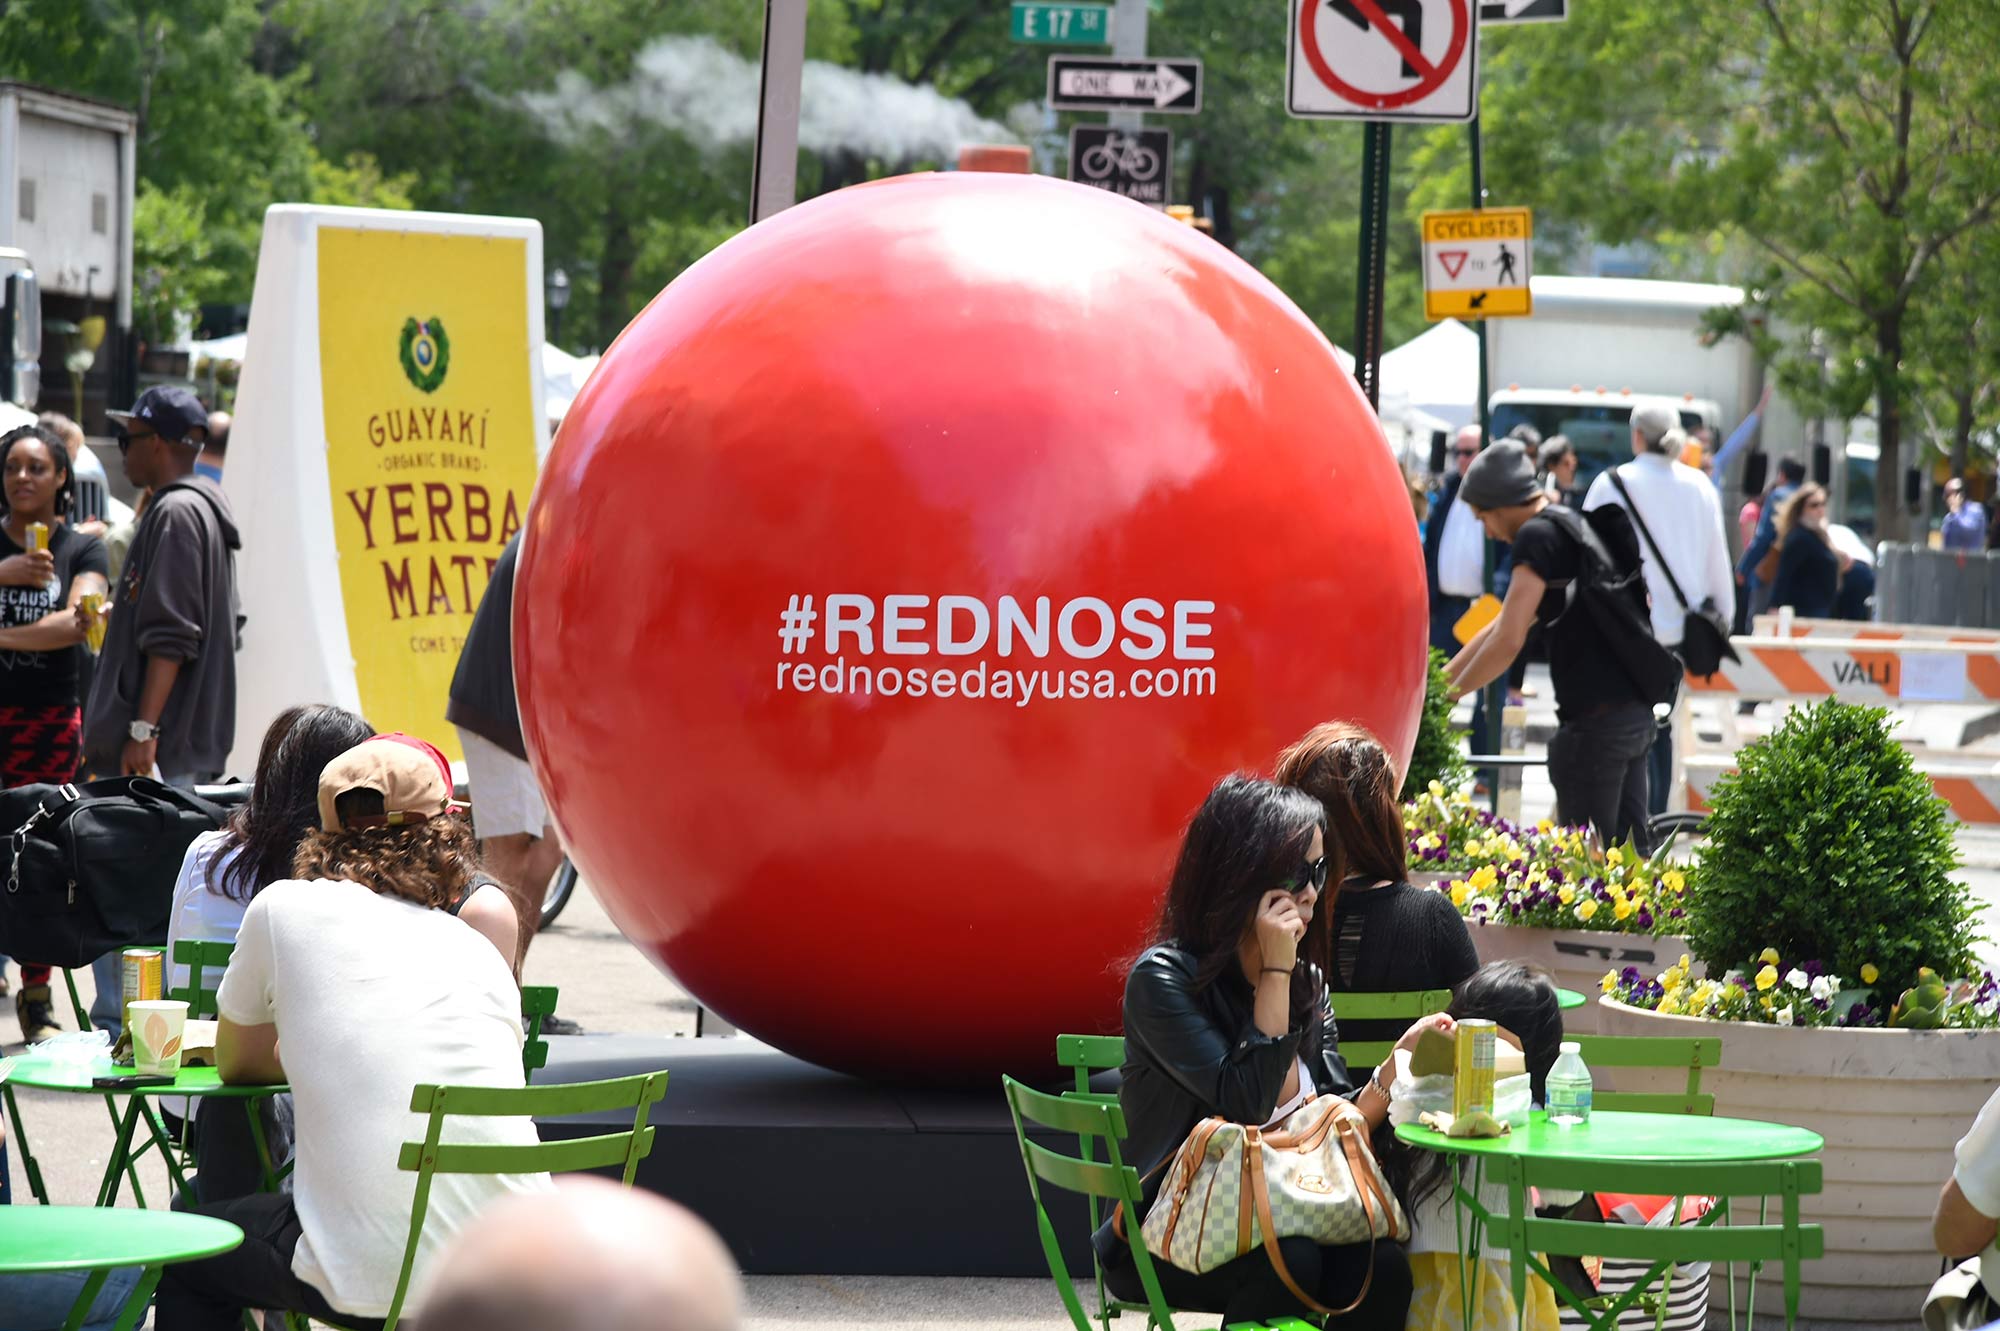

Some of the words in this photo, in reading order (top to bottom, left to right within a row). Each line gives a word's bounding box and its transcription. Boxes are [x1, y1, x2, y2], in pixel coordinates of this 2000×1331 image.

[1023, 9, 1038, 38] E
[1046, 10, 1073, 39] 17
[1071, 73, 1112, 95] ONE
[1133, 76, 1174, 95] WAY
[1116, 182, 1161, 200] LANE
[1433, 219, 1518, 239] CYCLISTS
[1472, 260, 1485, 271] TO
[384, 453, 436, 472] ORGANIC
[441, 453, 481, 472] BRAND
[345, 482, 522, 550] YERBA
[0, 587, 57, 608] ECAUSE
[777, 594, 1216, 660] #REDNOSE
[410, 636, 447, 654] COME
[776, 656, 1217, 708] rednosedayusa.com
